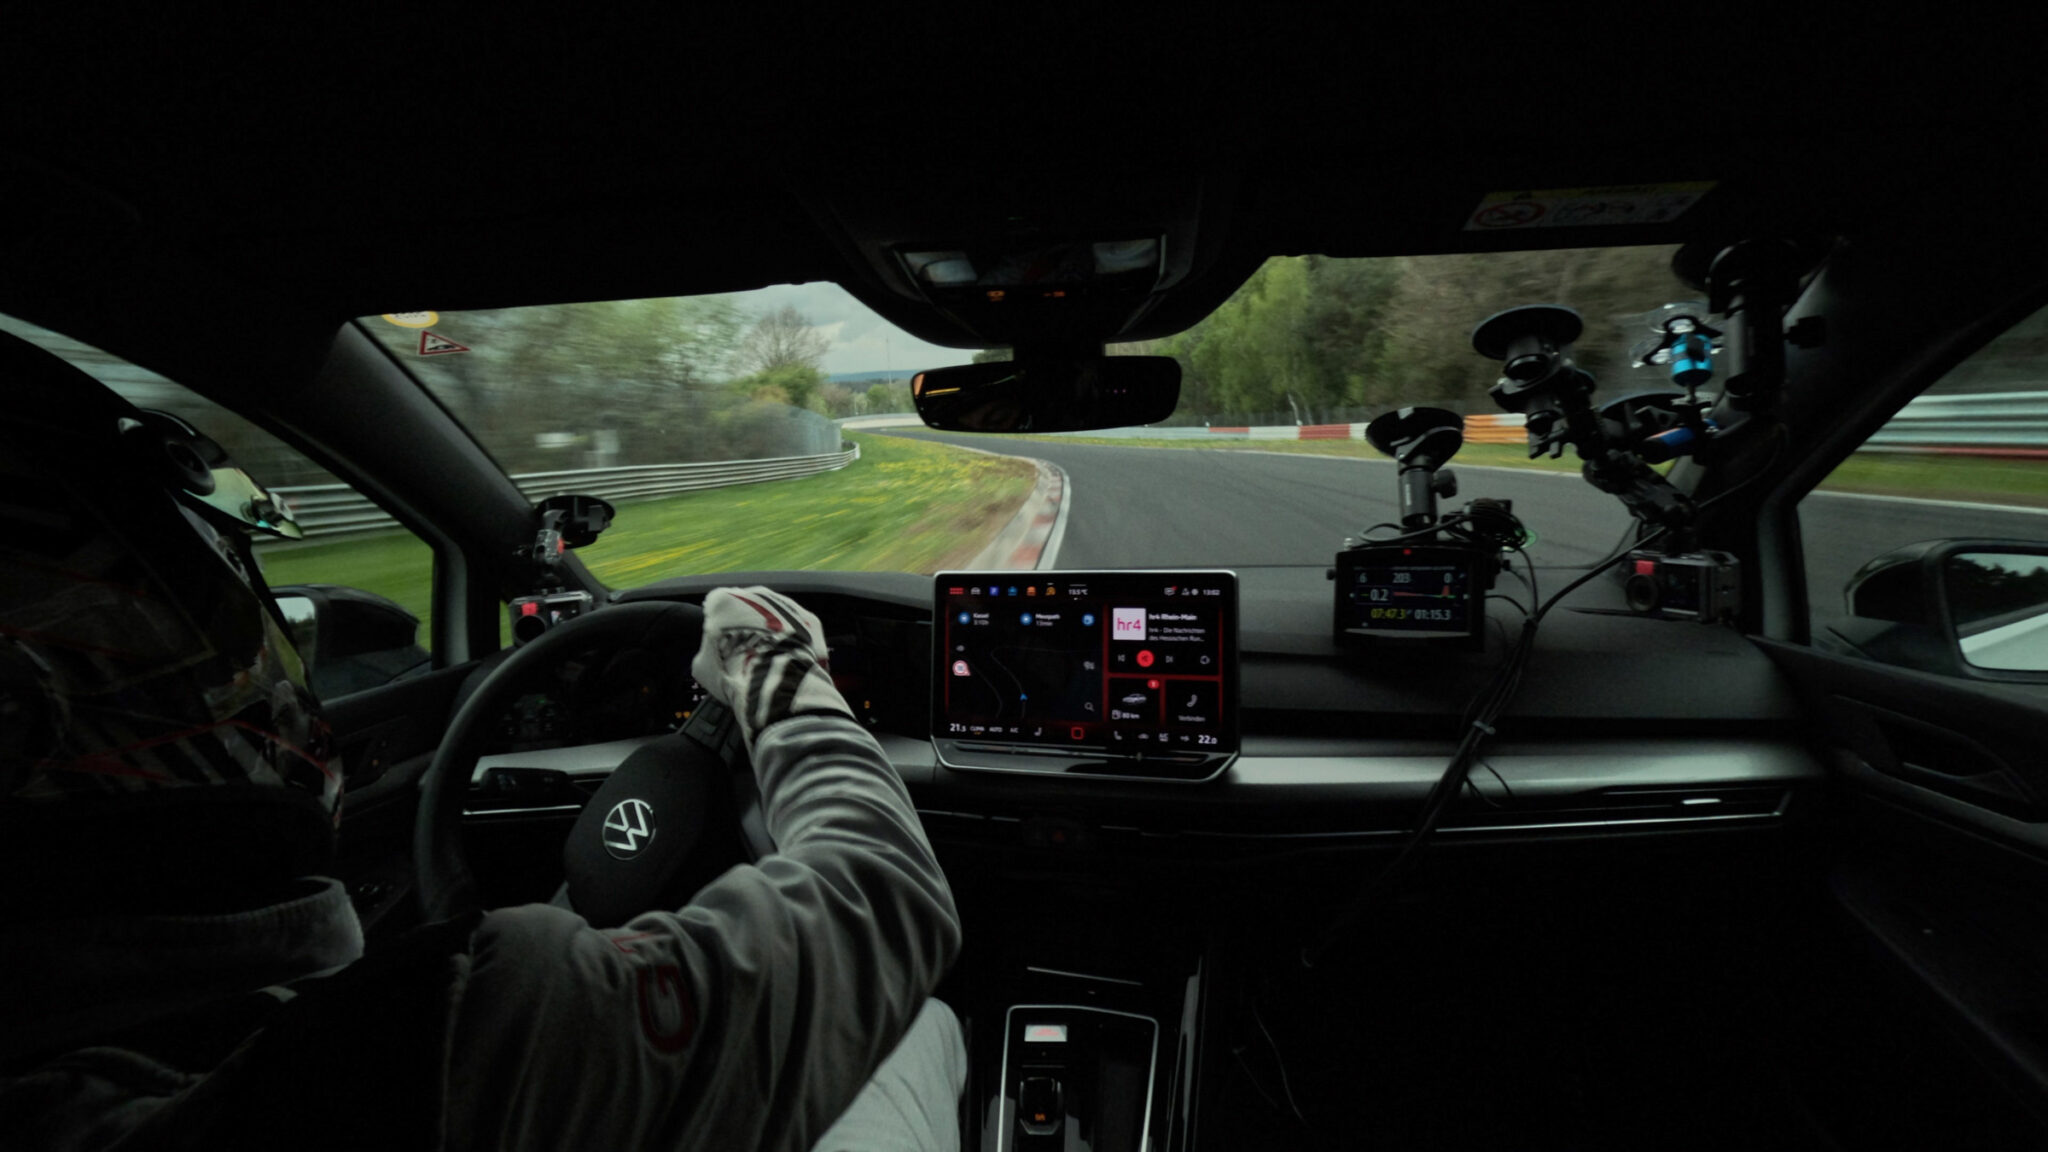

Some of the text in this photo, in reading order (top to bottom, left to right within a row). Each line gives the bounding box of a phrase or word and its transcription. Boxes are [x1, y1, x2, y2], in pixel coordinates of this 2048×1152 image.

[1359, 572, 1368, 583] 6
[1392, 572, 1412, 584] 203
[1443, 572, 1453, 584] 0
[1370, 588, 1389, 602] 0.2
[1148, 613, 1197, 621] hr4 Rhein-Main
[1116, 617, 1142, 631] hr4
[1178, 714, 1206, 722] Verbinden
[949, 722, 967, 733] 21.5
[1197, 734, 1218, 745] 22.0
[603, 798, 654, 857] VW
